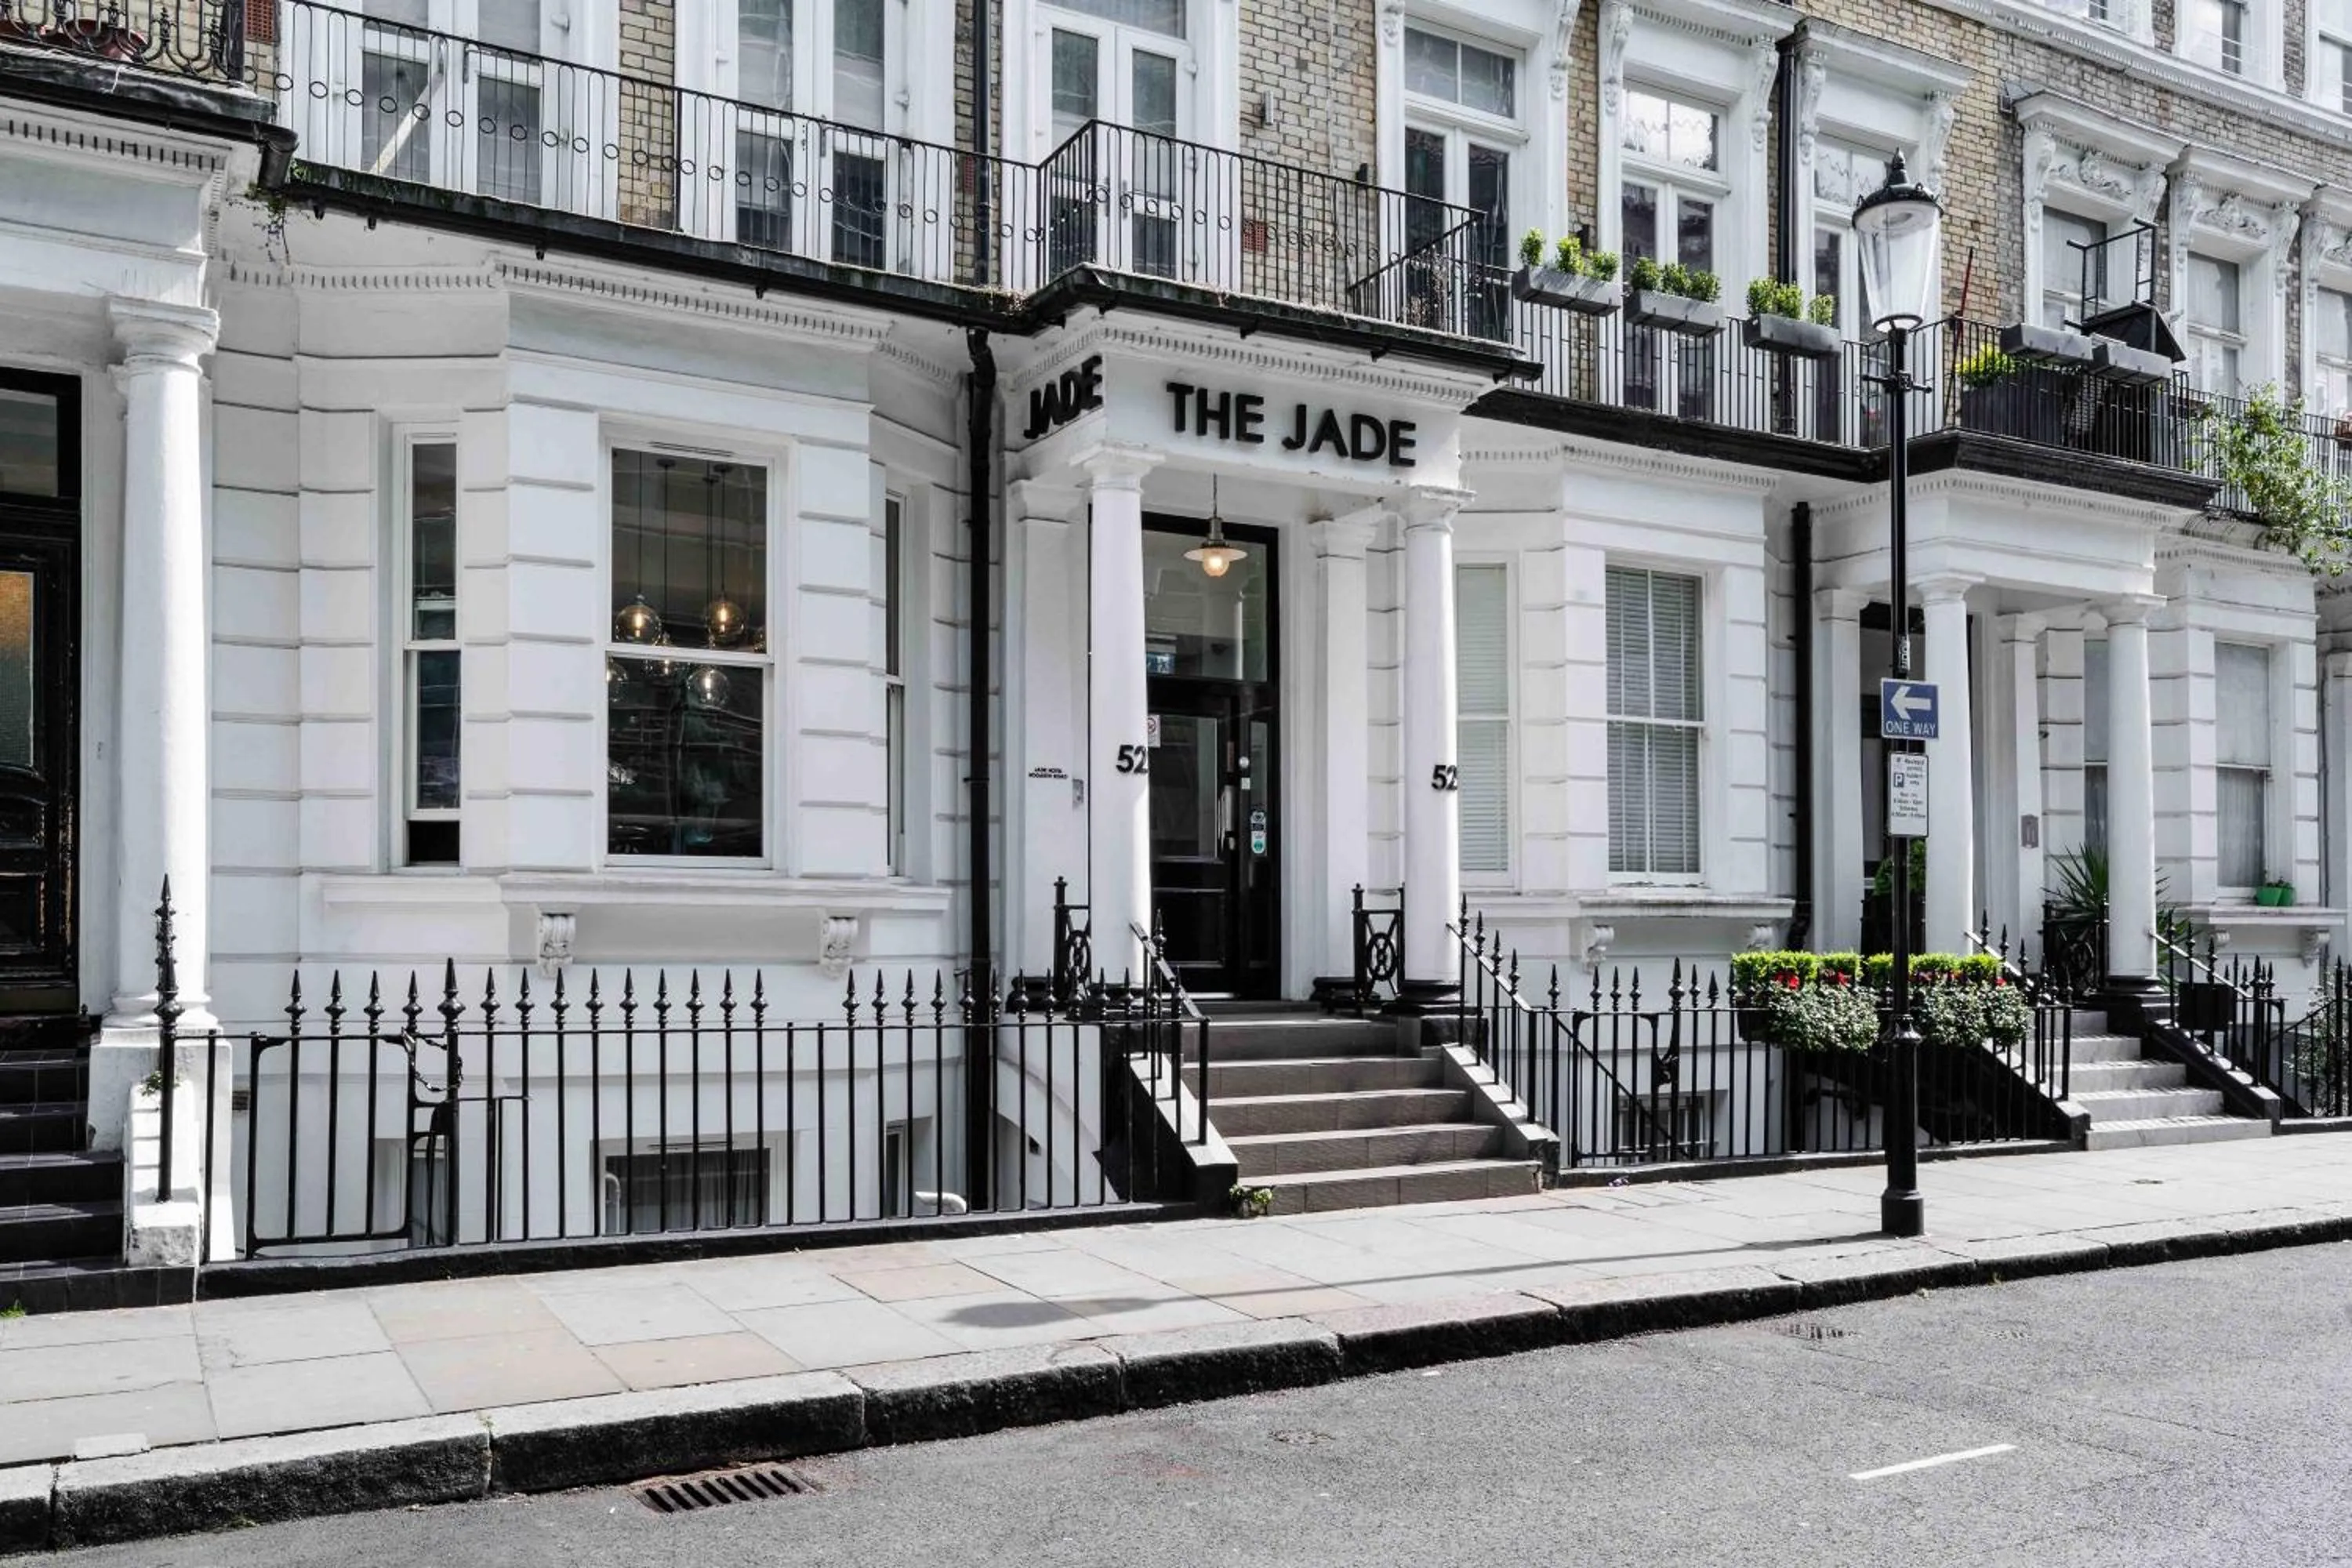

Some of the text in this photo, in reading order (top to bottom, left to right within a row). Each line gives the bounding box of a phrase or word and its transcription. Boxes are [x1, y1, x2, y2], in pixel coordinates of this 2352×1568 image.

[1023, 354, 1102, 439] JADE
[1167, 382, 1416, 466] THE JADE
[1886, 720, 1936, 737] ONE WAY
[1116, 744, 1149, 774] 52
[1432, 764, 1457, 791] 52
[1895, 774, 1903, 786] P
